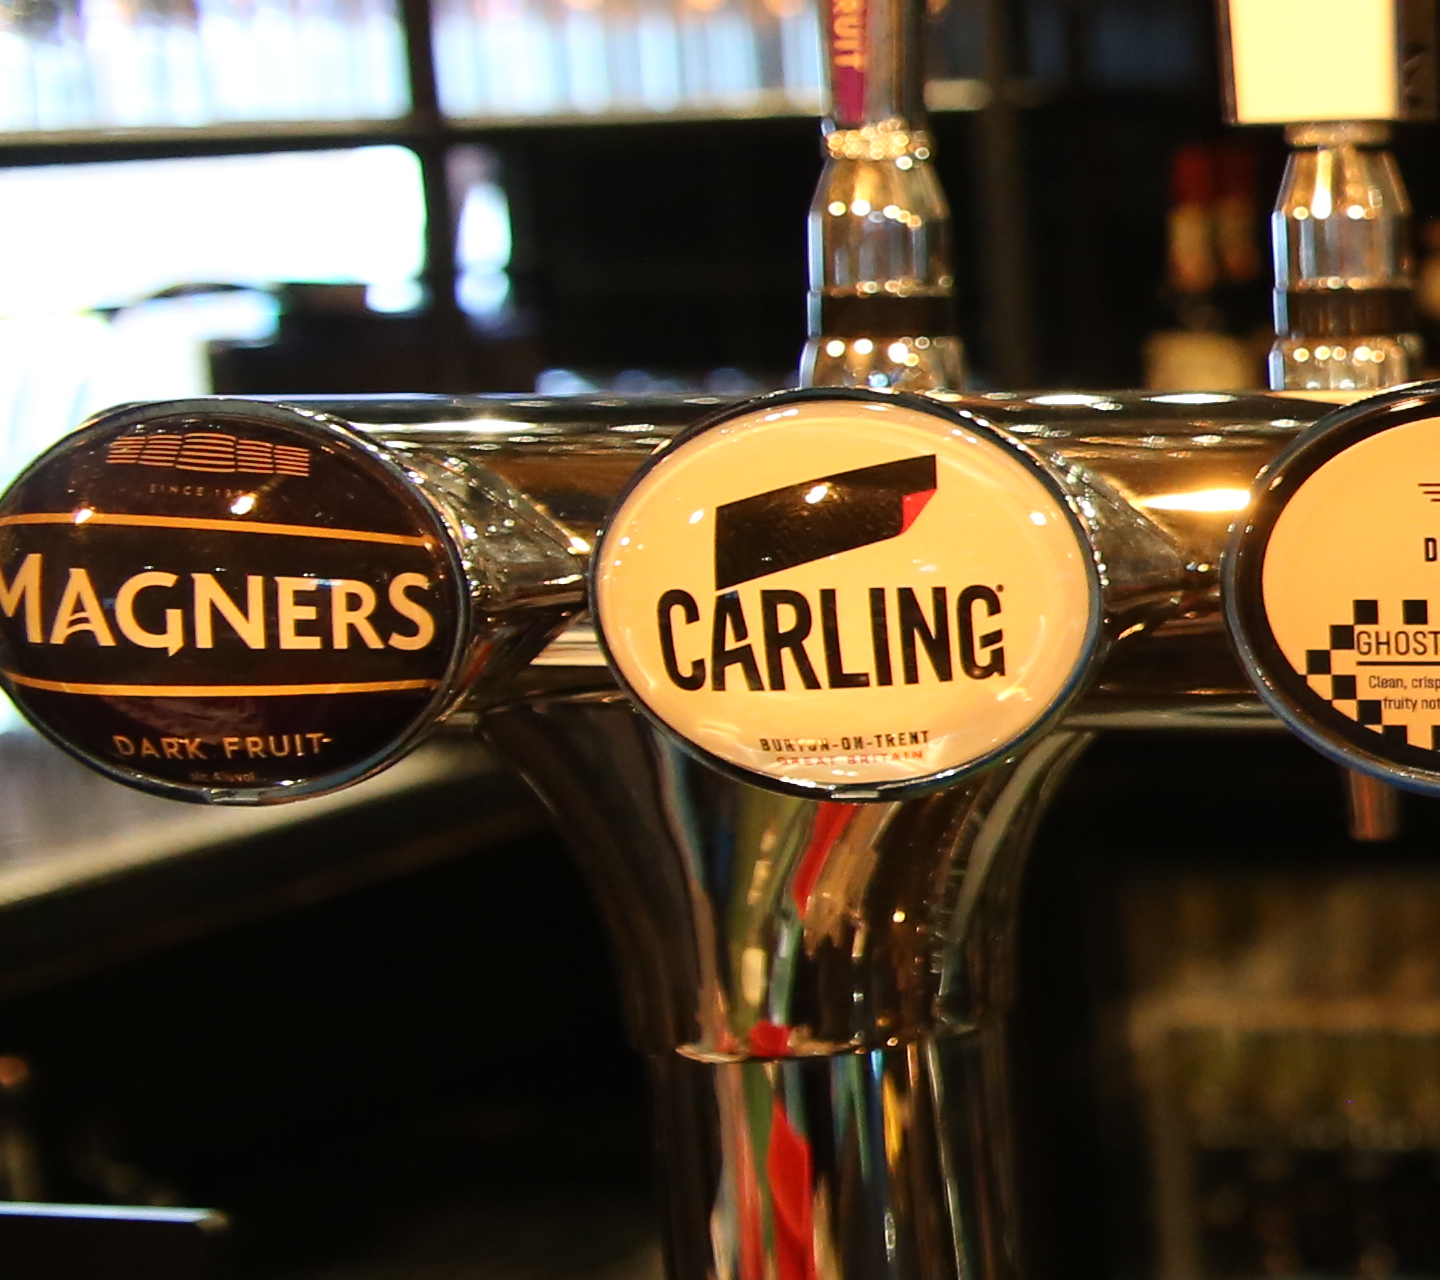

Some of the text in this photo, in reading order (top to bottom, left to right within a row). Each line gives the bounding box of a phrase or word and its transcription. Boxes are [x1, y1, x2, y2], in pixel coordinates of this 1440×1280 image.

[0, 553, 436, 657] MAGNERS
[656, 583, 1007, 692] CARLING
[1368, 674, 1408, 691] Clean,
[1383, 695, 1419, 713] fruity
[112, 733, 327, 761] DARK FRUIT
[759, 729, 930, 752] BURTON-ON-TRENT
